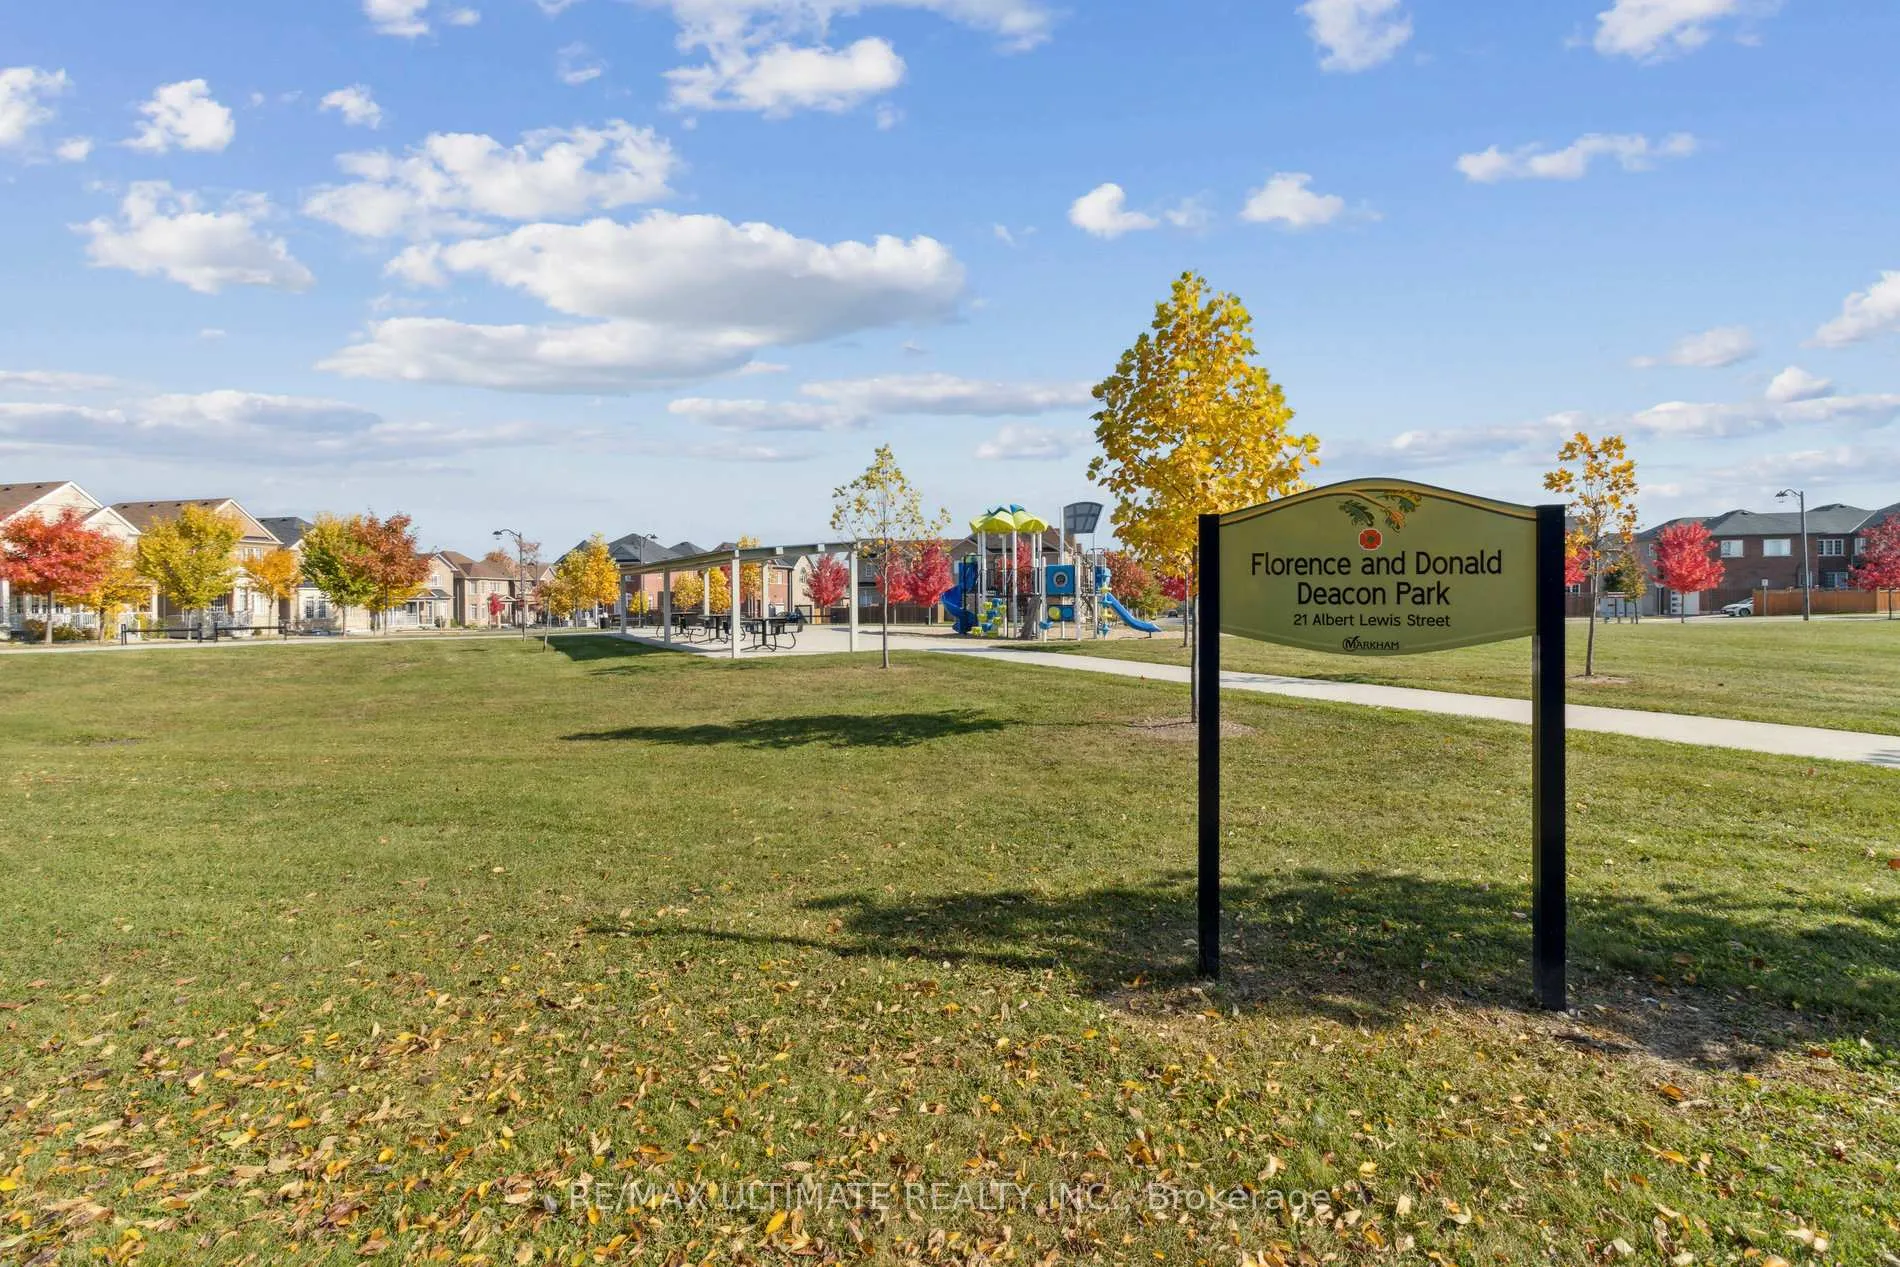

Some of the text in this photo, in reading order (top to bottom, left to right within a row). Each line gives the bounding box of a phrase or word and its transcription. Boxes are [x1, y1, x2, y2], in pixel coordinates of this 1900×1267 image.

[1251, 550, 1502, 576] Florence and Donald
[1297, 581, 1450, 605] Deacon Park
[1293, 613, 1451, 627] 21 Albert Lewis Street
[1343, 635, 1400, 651] MARKHAM
